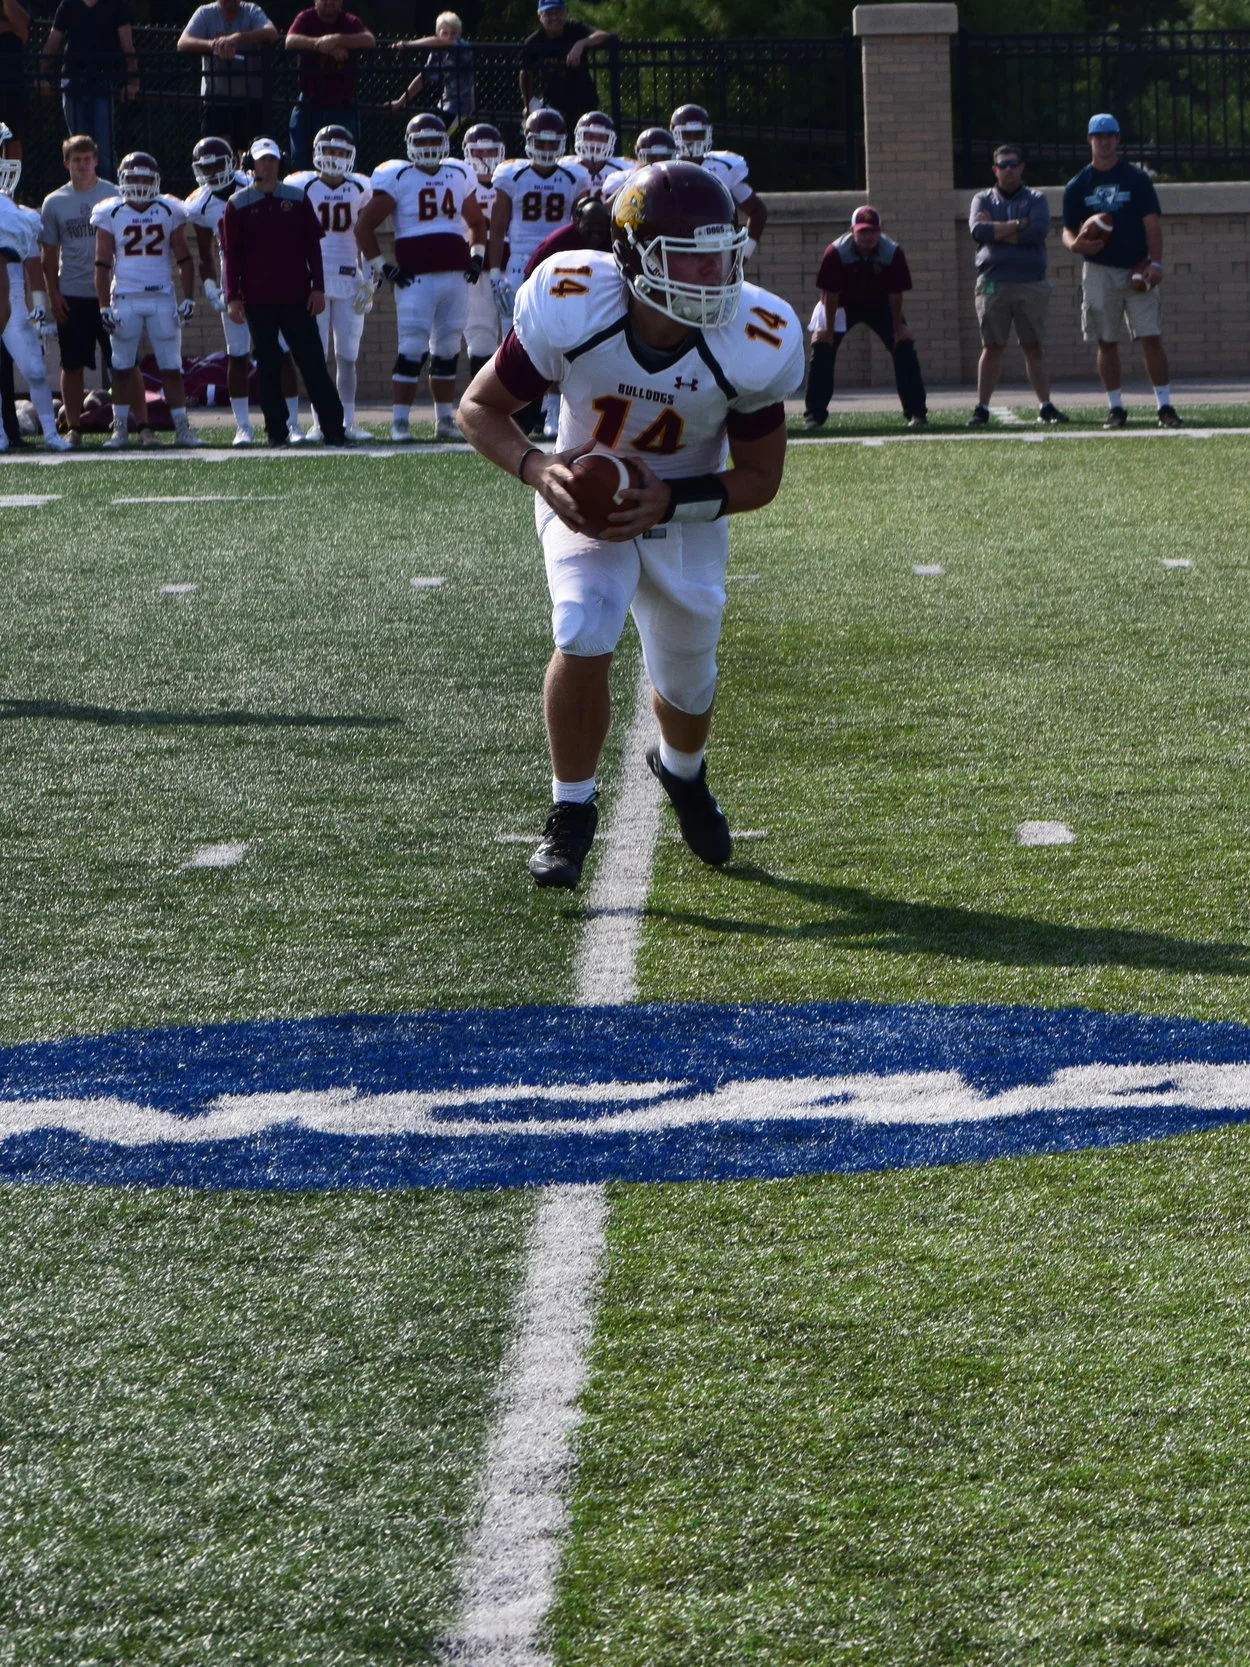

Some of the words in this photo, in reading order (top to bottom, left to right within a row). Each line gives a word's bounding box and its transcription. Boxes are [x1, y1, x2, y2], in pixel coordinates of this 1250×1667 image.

[317, 201, 352, 232] 10
[418, 187, 457, 222] 64
[522, 191, 565, 222] 88
[123, 223, 166, 257] 22
[549, 264, 593, 299] 14
[744, 304, 789, 351] 14
[617, 383, 675, 405] BULLDOGS
[592, 394, 687, 455] 14
